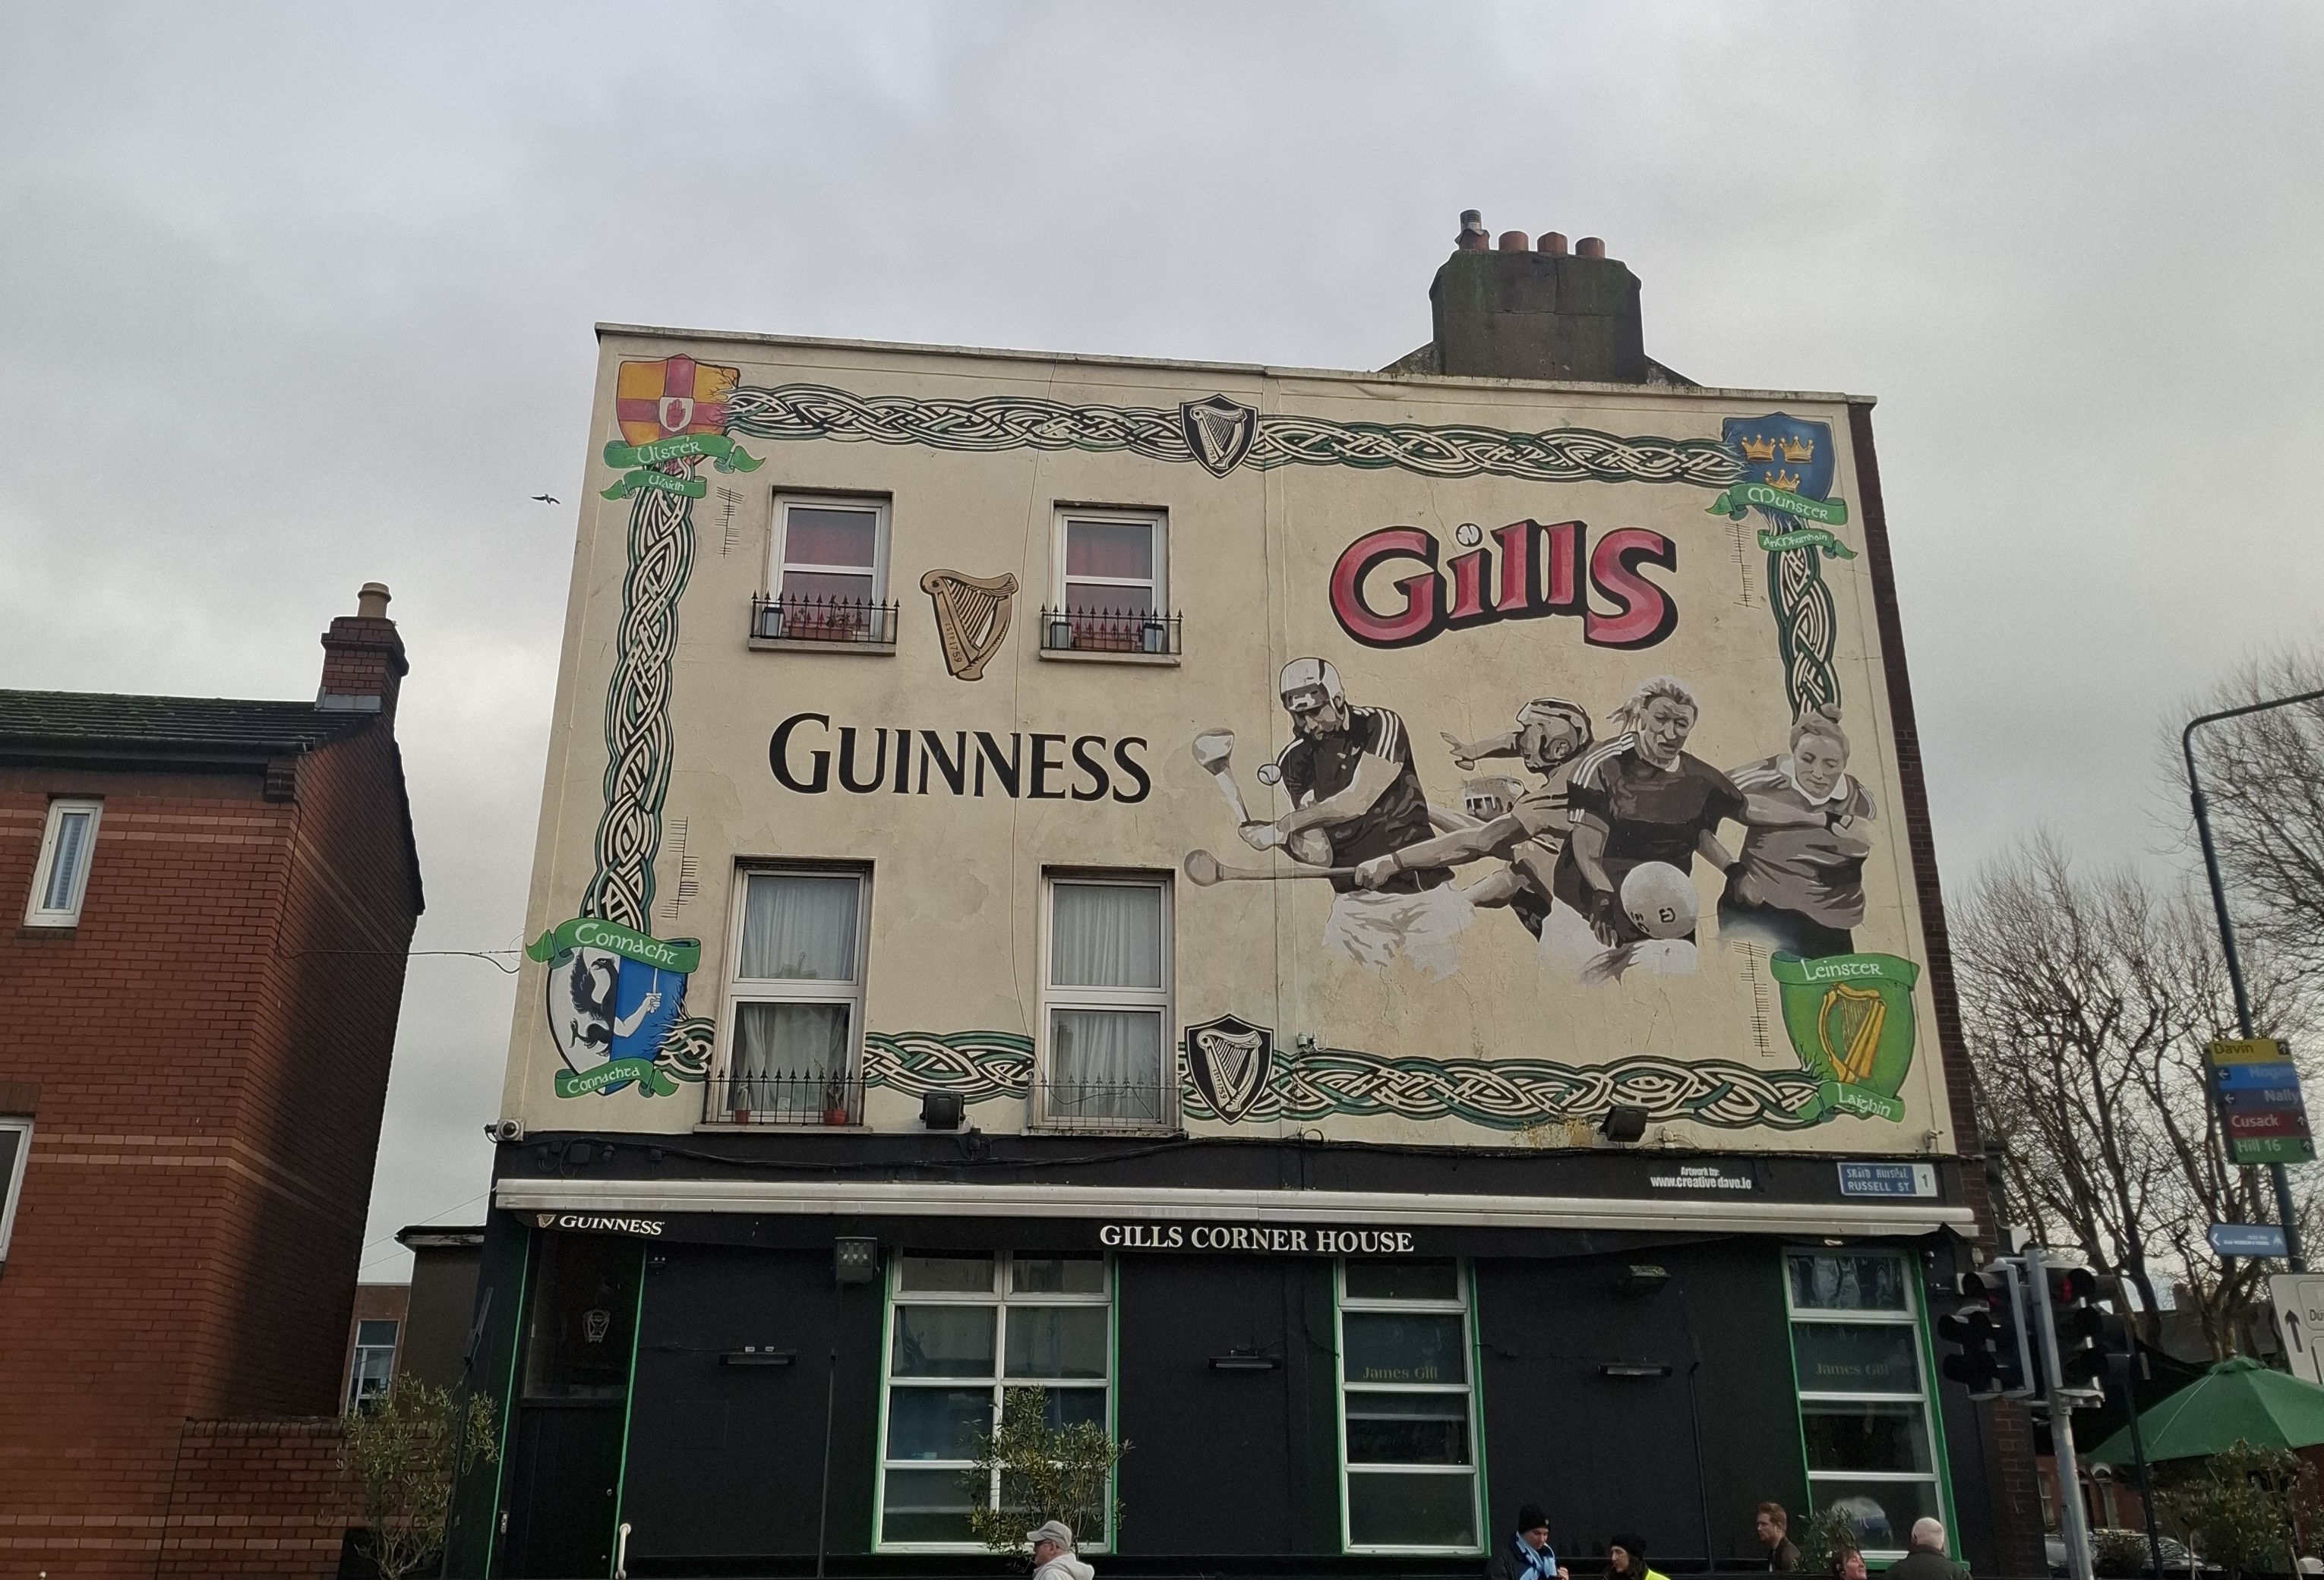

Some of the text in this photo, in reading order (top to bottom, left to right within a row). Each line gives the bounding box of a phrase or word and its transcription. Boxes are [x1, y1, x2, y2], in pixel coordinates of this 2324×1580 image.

[1748, 487, 1828, 519] Munster
[769, 712, 1151, 804] GUINNESS
[575, 922, 679, 964] Connacht
[1801, 958, 1884, 981] Leinster
[2213, 1042, 2254, 1054] Davin
[567, 1067, 640, 1093] Connachta
[2264, 1089, 2300, 1104] Nally
[2231, 1114, 2280, 1127] Cusack
[2237, 1140, 2281, 1153] Hill 16
[1847, 1181, 1891, 1191] RUSSELL
[1921, 1174, 1928, 1187] 1
[560, 1216, 664, 1235] GUINNESS
[1100, 1225, 1414, 1253] GILLS CORNER HOUSE
[1363, 1367, 1410, 1380] James
